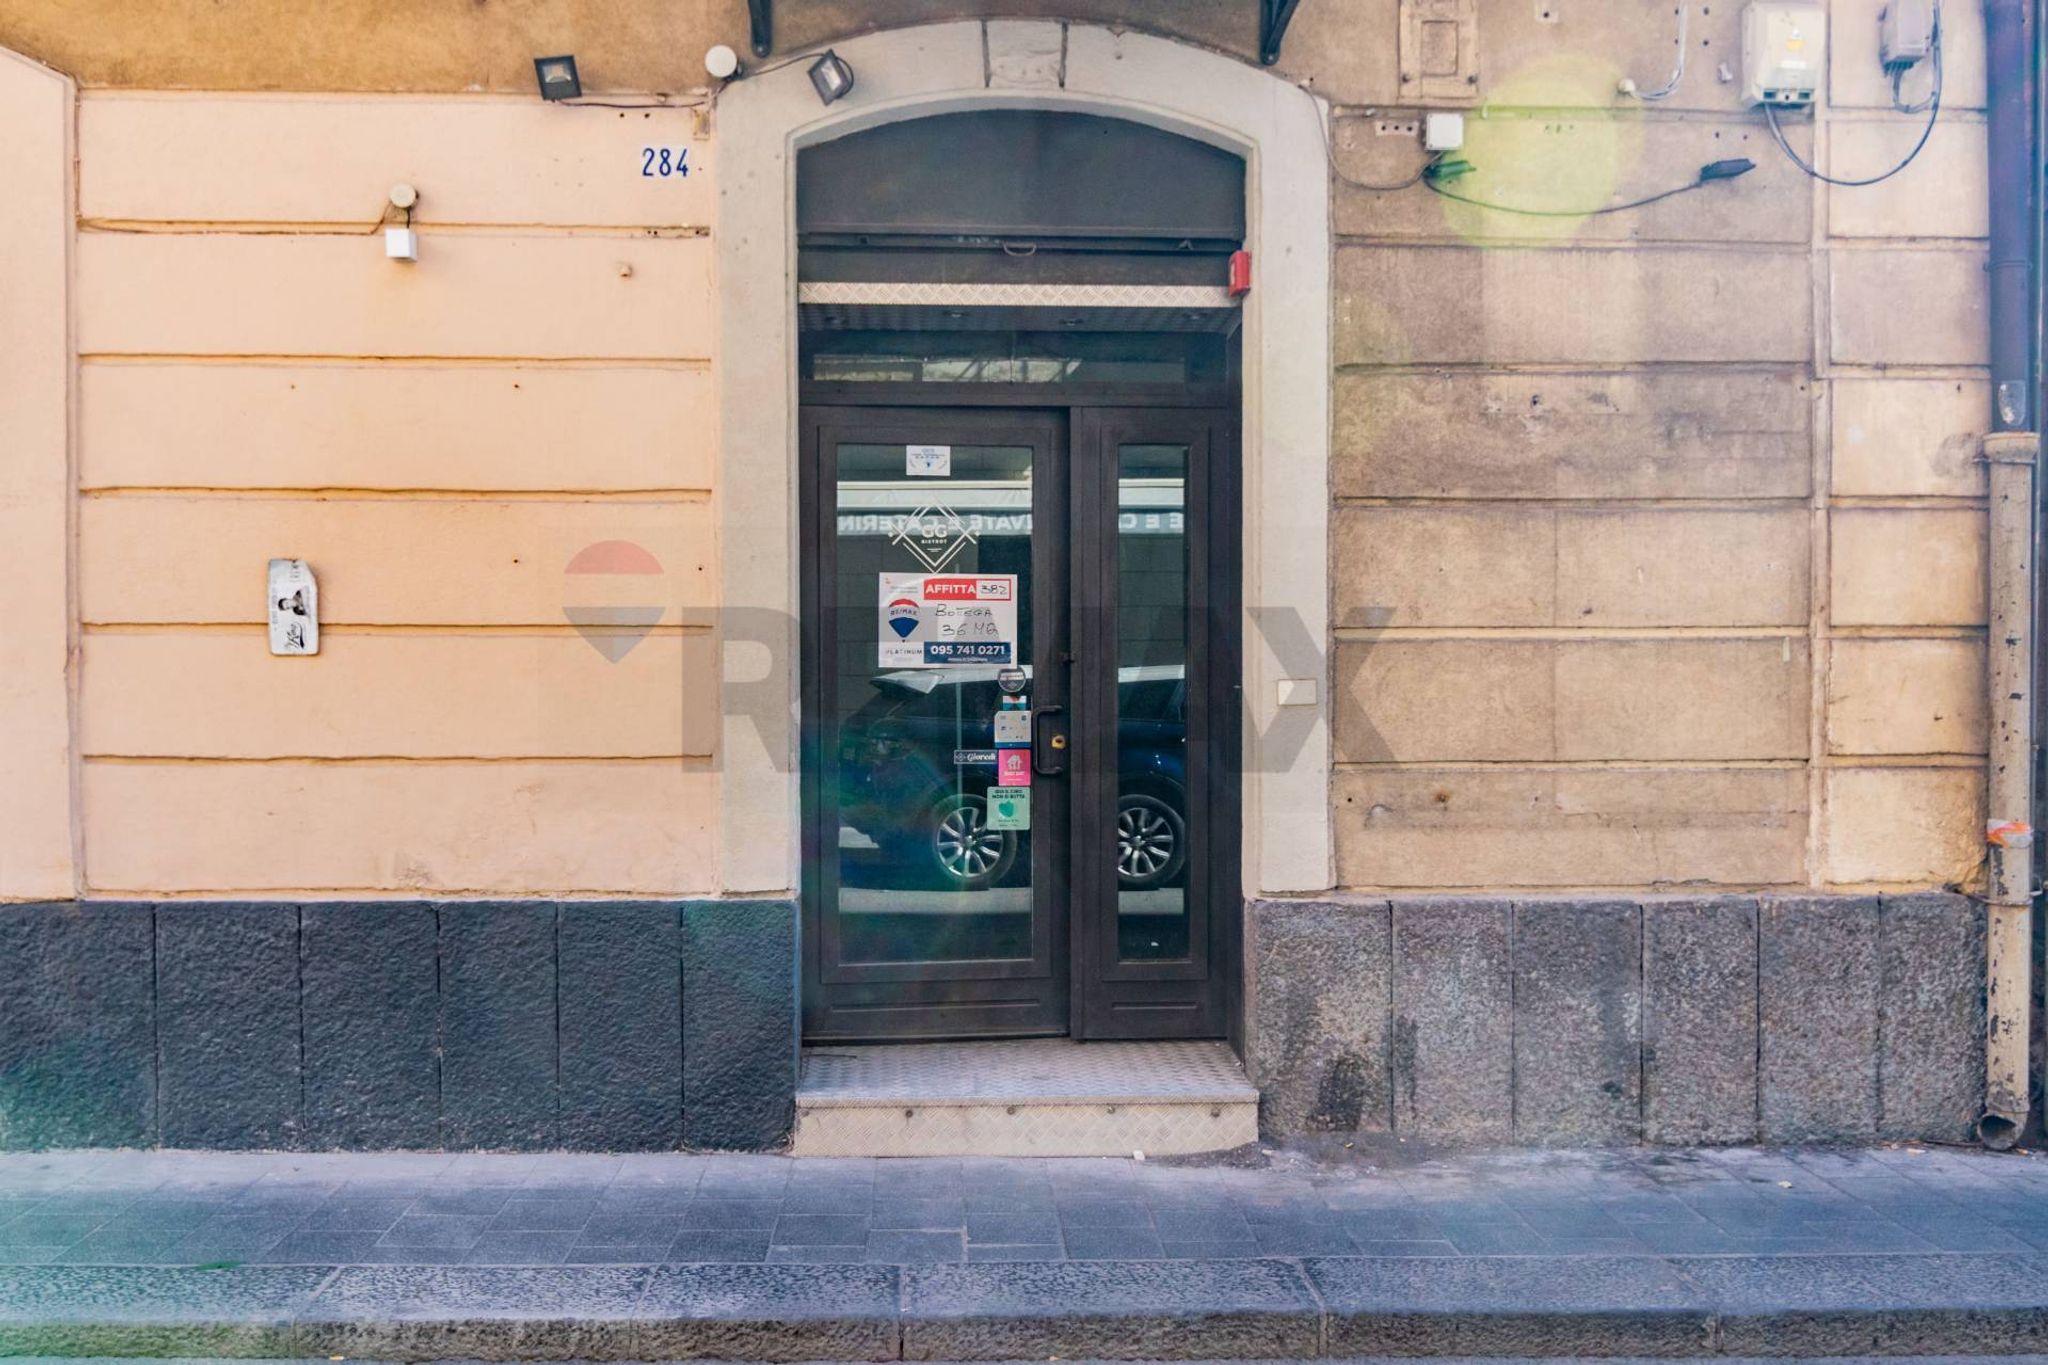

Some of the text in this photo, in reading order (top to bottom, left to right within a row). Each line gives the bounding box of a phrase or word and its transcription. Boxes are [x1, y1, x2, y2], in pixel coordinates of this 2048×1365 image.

[642, 147, 688, 176] 284
[925, 584, 976, 594] AFFITTA
[942, 624, 967, 636] 36
[930, 645, 1005, 655] 095 741 0271
